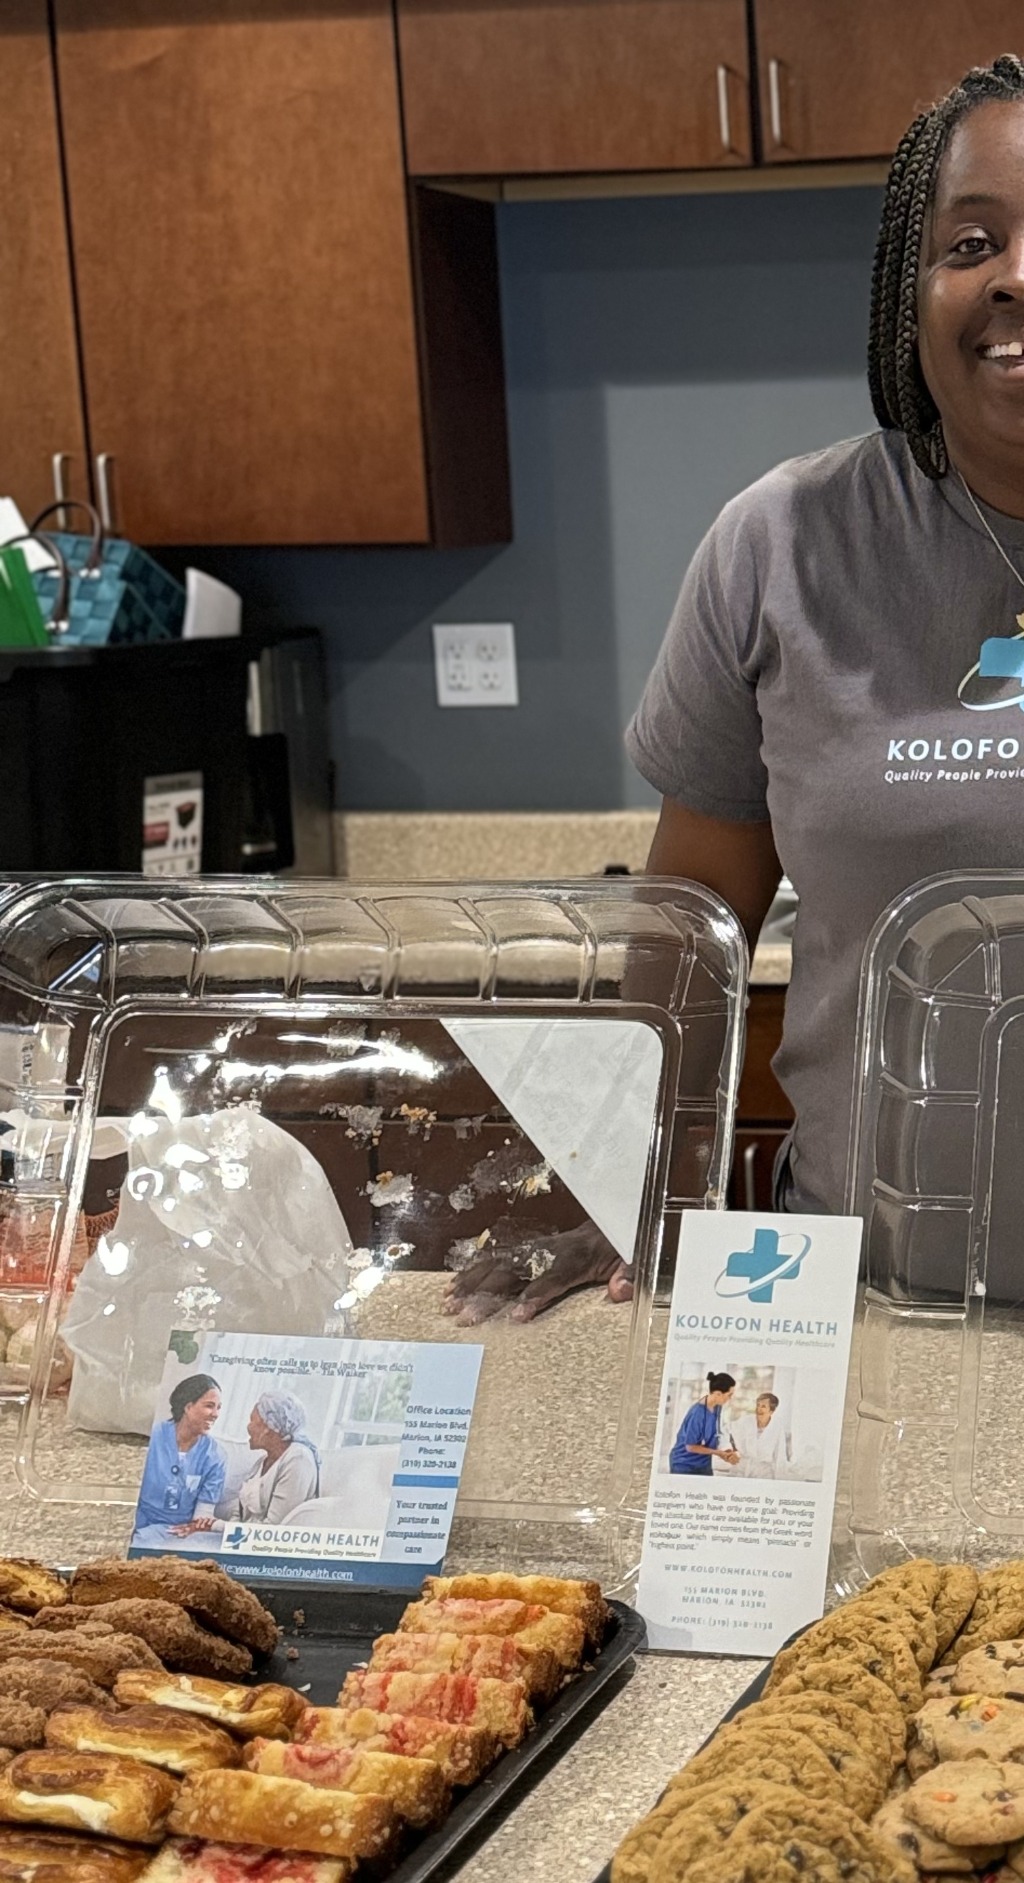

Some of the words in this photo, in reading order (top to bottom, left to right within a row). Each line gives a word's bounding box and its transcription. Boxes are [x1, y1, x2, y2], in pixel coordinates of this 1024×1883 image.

[884, 768, 933, 784] Quality
[936, 768, 981, 783] People
[676, 1314, 762, 1331] KOLOFON
[769, 1318, 838, 1336] HEALTH
[406, 1405, 432, 1414] Office
[434, 1406, 471, 1415] Location
[419, 1420, 448, 1429] Marion
[253, 1529, 318, 1545] KOLOFON
[327, 1532, 380, 1547] HEALTH
[700, 1587, 738, 1596] MARION
